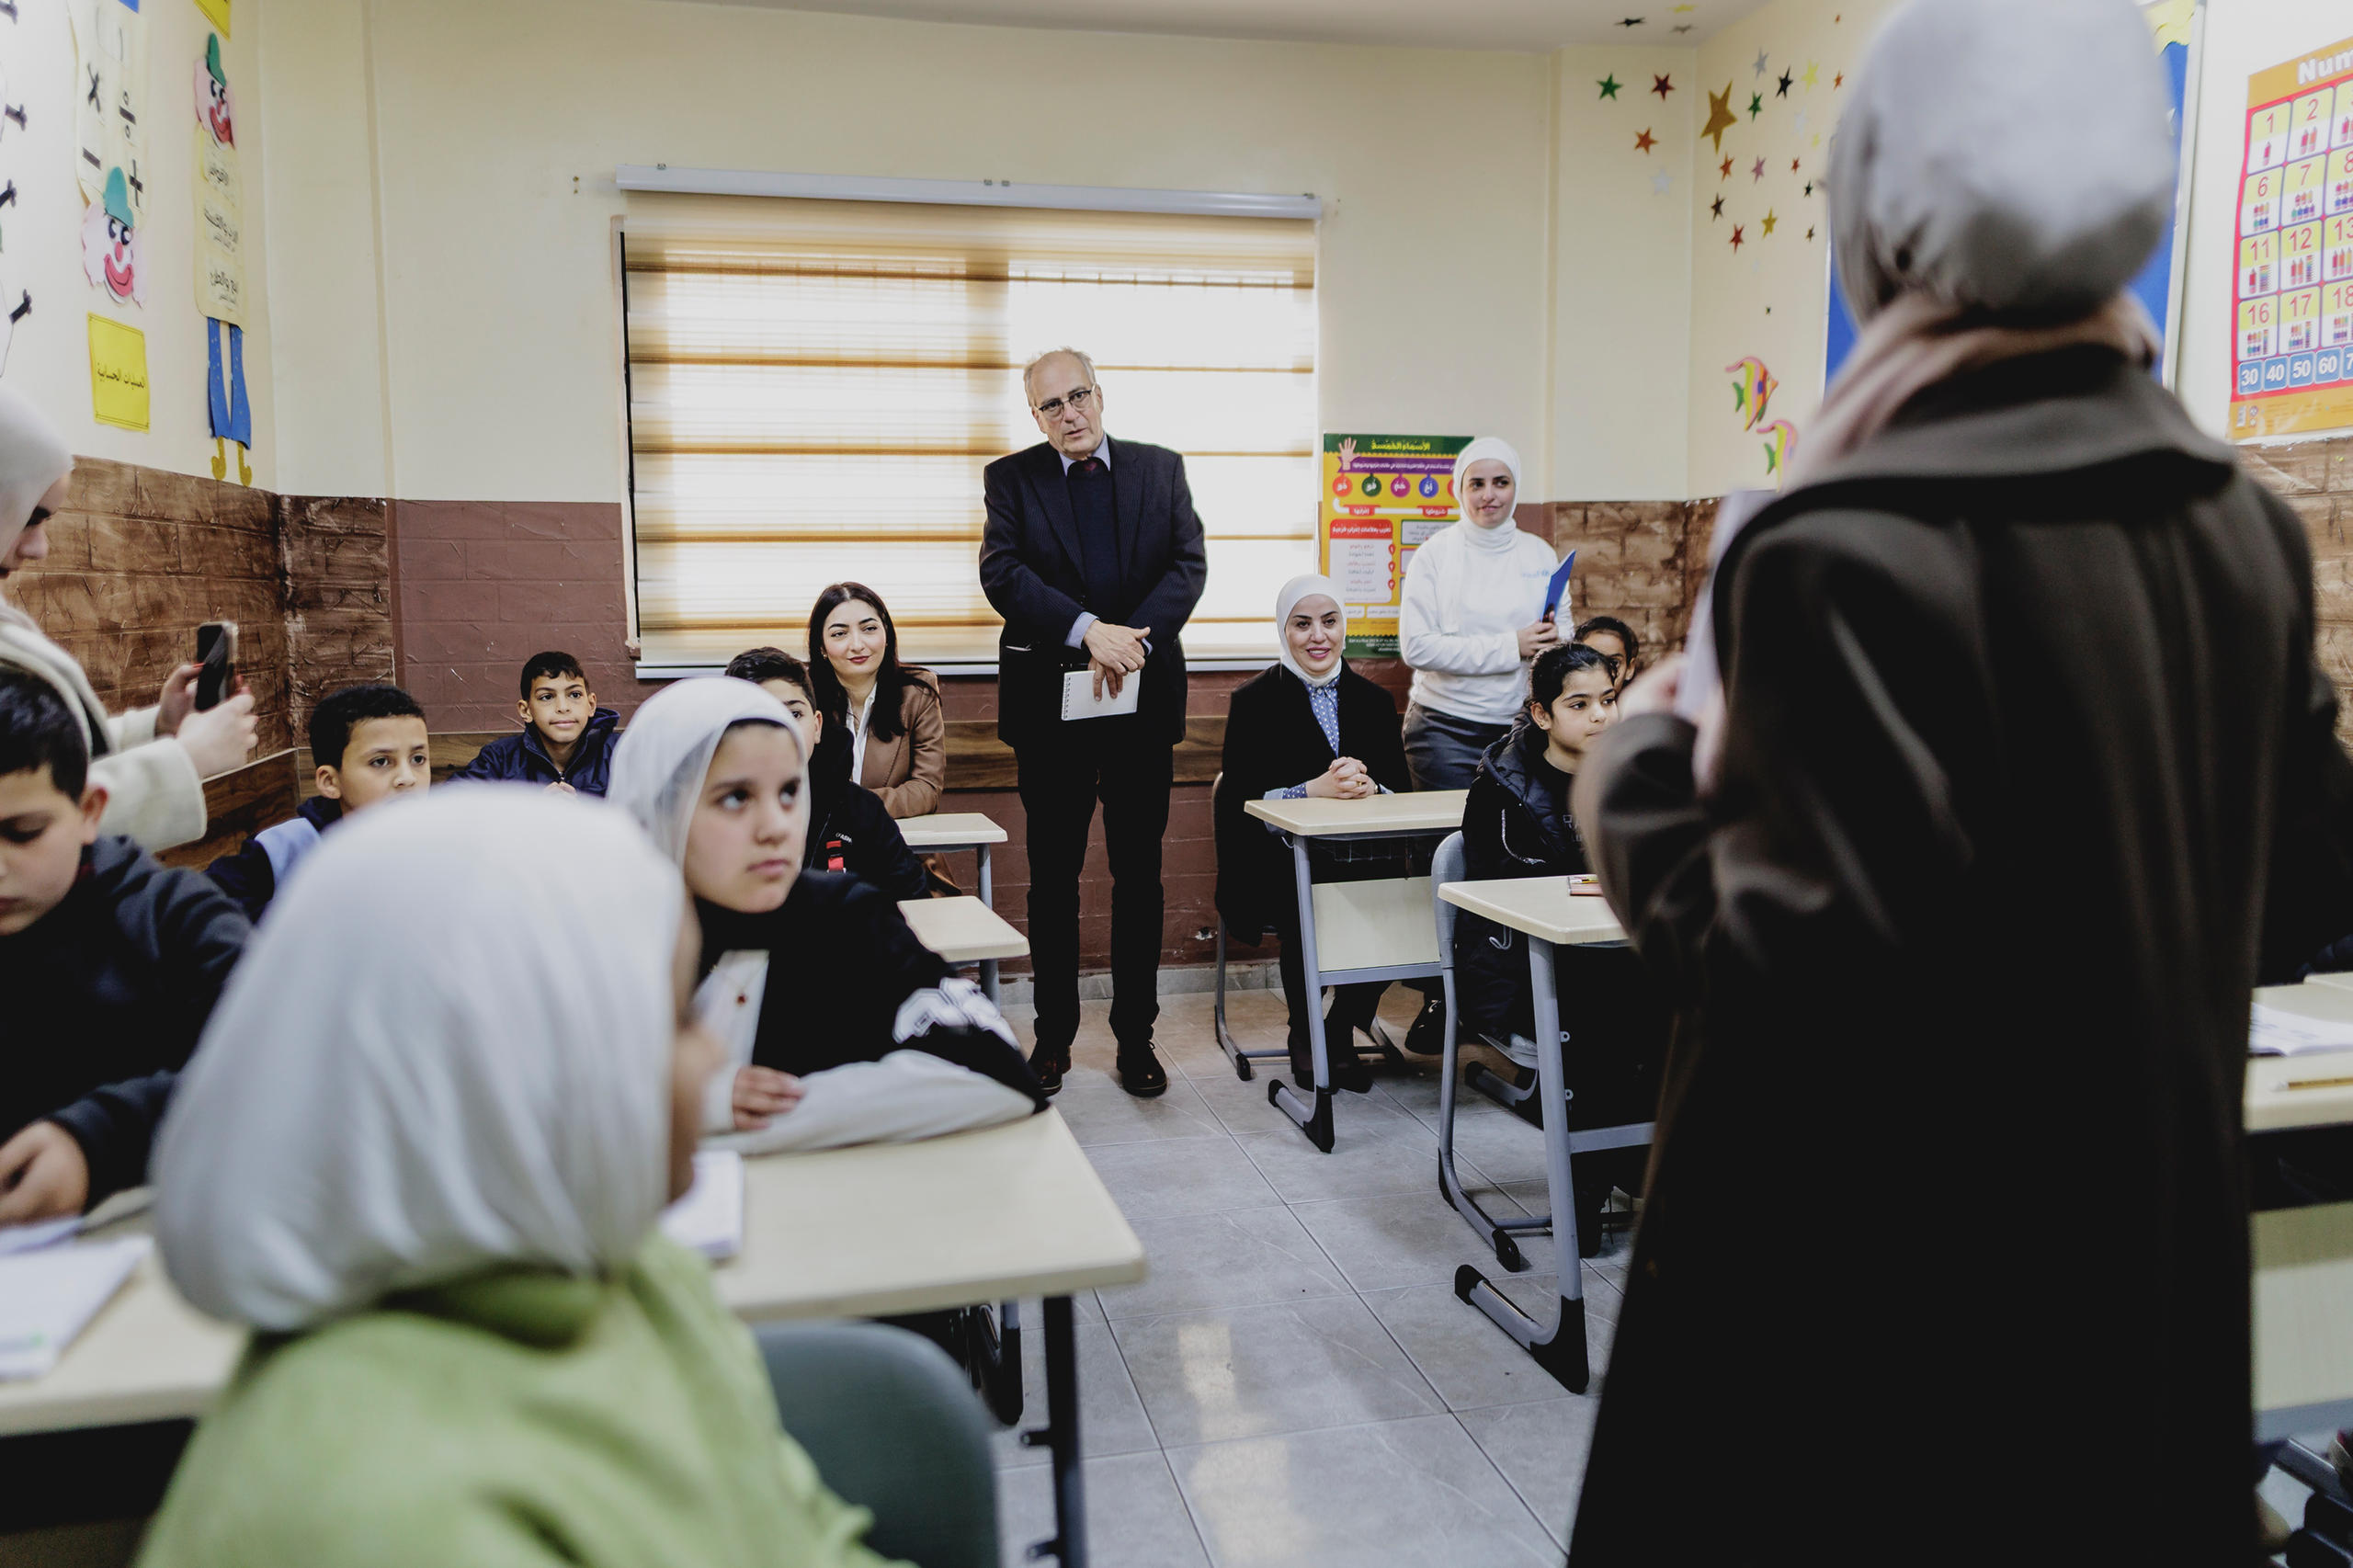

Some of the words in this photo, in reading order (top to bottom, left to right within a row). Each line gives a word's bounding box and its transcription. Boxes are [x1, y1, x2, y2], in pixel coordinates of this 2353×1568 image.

[2267, 112, 2274, 133] 1
[2306, 98, 2319, 121] 2
[2257, 176, 2268, 197] 6
[2300, 164, 2312, 186] 7
[2250, 237, 2269, 261] 11
[2289, 227, 2312, 252] 12
[2247, 301, 2269, 326] 16
[2290, 293, 2312, 317] 17
[2241, 368, 2258, 387] 30
[2266, 363, 2285, 382] 40
[2292, 358, 2311, 379] 50
[2318, 355, 2337, 375] 60
